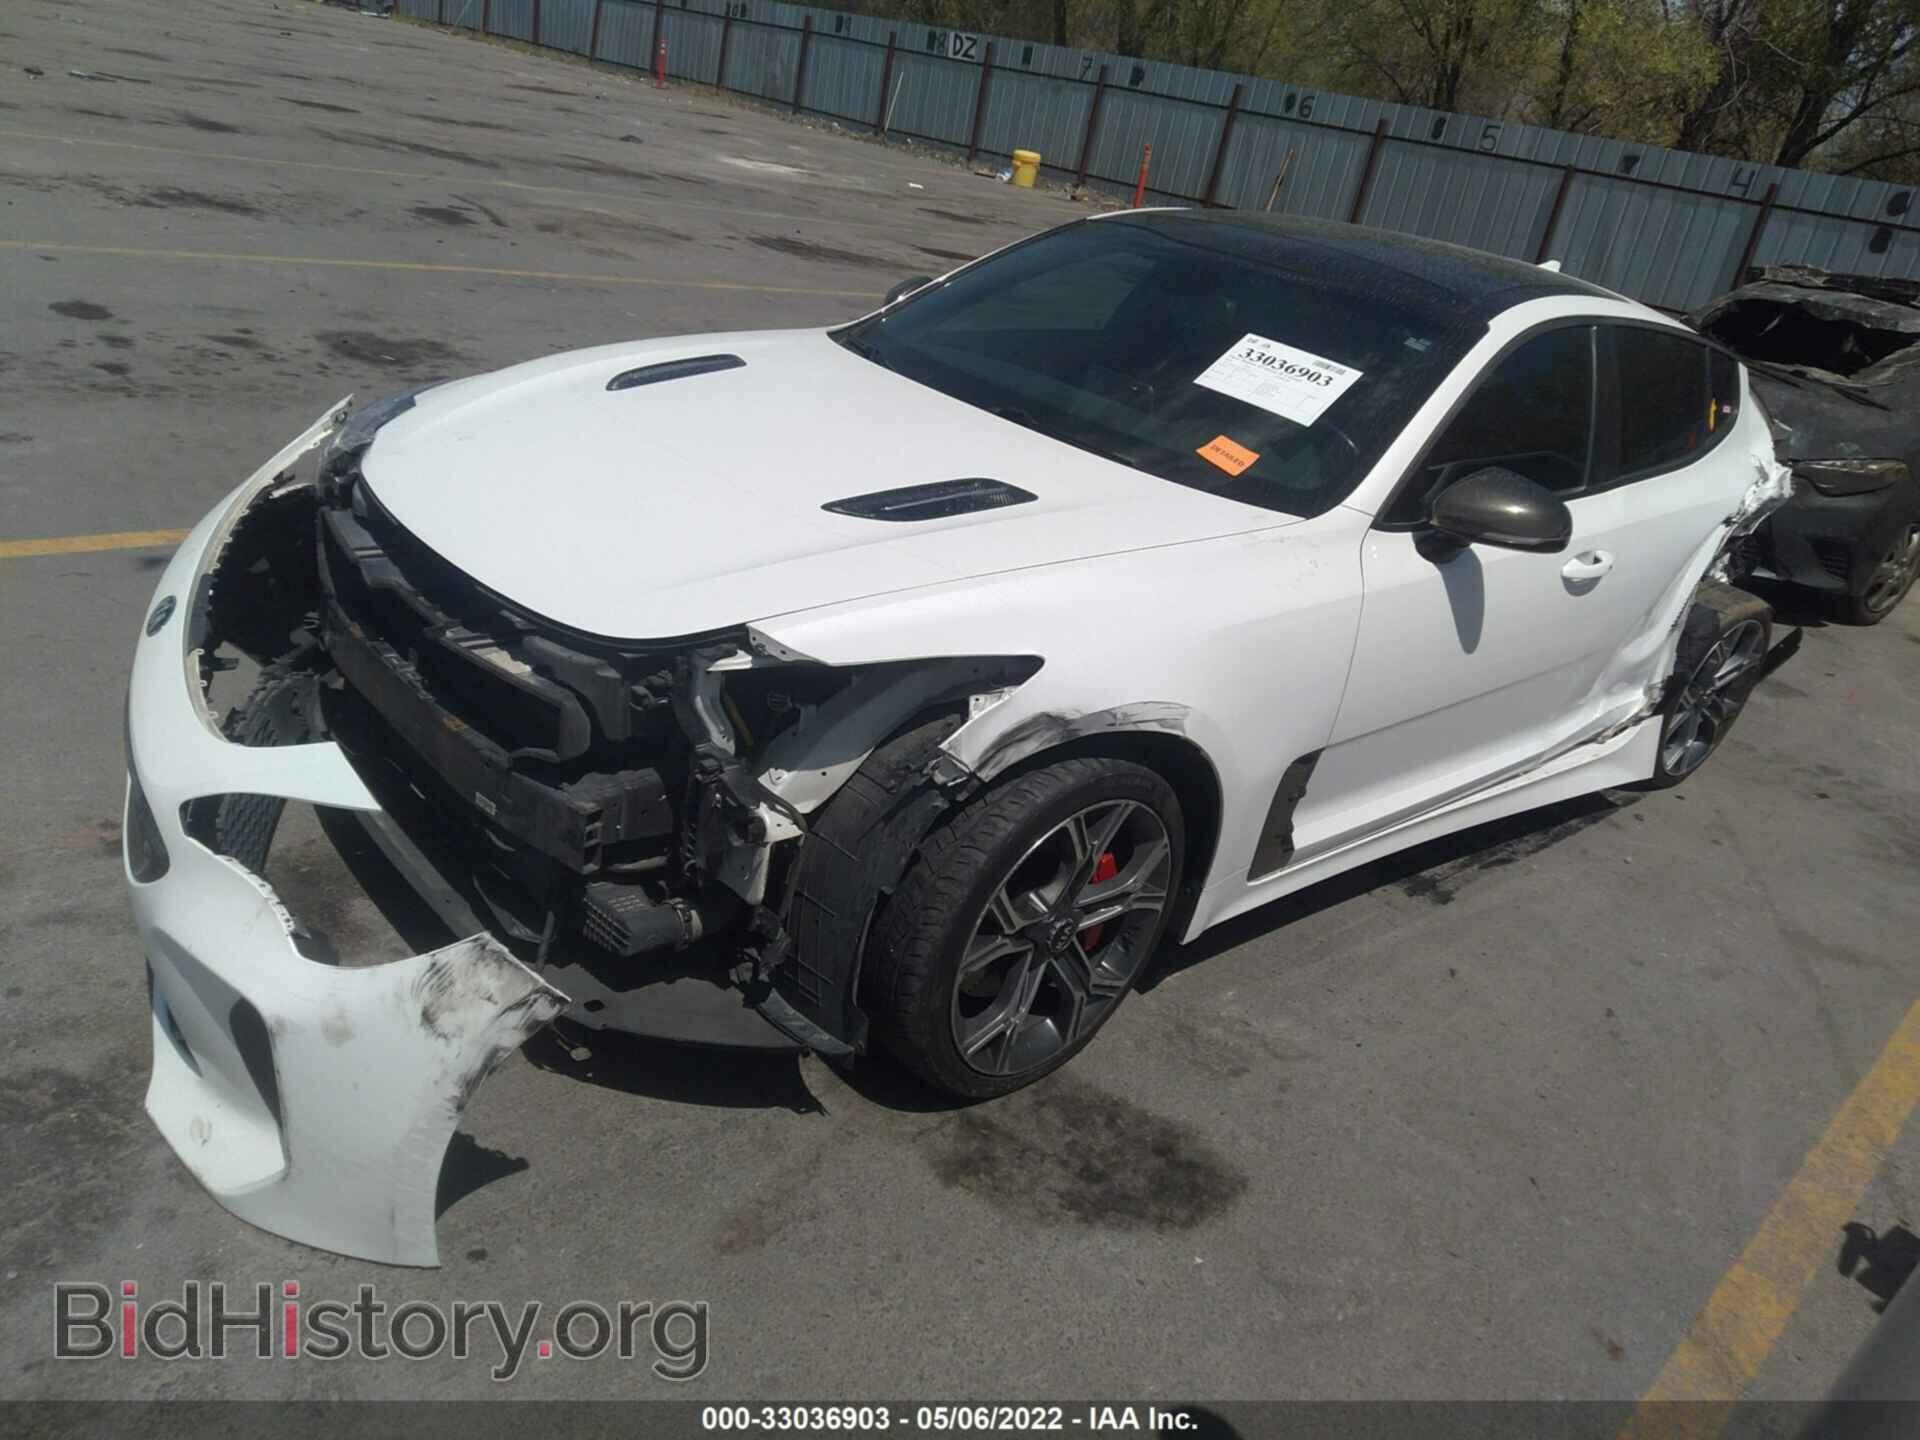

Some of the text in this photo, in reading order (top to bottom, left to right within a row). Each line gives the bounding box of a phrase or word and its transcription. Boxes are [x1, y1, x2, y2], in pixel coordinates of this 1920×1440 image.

[952, 32, 978, 60] DZ
[1081, 56, 1093, 80] 7
[1298, 95, 1315, 118] 6
[1479, 124, 1501, 151] 5
[1732, 167, 1756, 197] 4
[1238, 347, 1334, 387] 33036903
